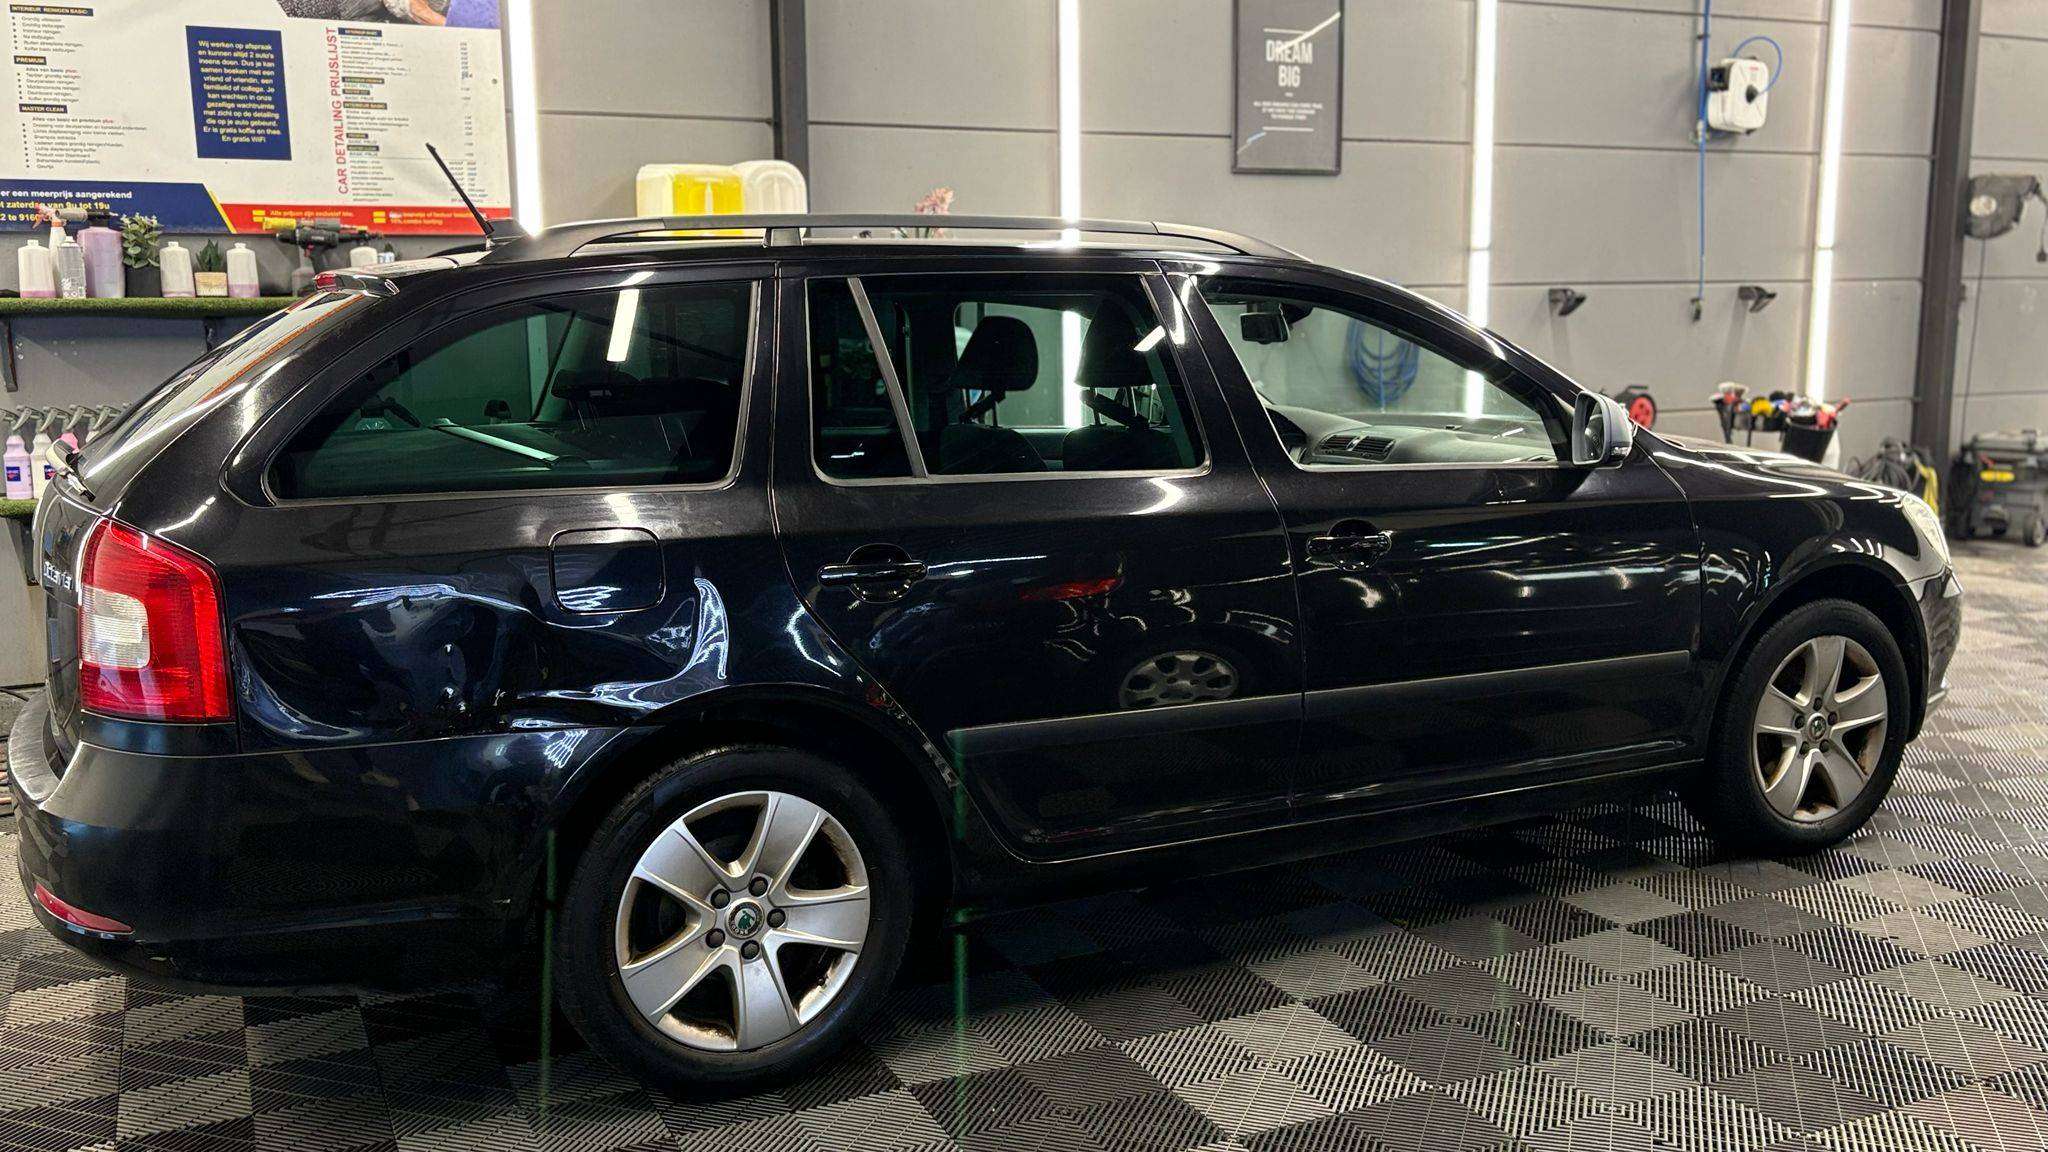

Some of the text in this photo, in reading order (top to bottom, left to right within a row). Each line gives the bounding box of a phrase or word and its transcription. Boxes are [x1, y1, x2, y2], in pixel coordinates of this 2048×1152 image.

[1266, 40, 1313, 64] DREAM
[1278, 65, 1301, 88] BIG
[326, 26, 348, 194] CAR DETAILING PRIJSLIJST
[31, 190, 73, 199] meerprijs
[75, 191, 132, 199] aangerekend
